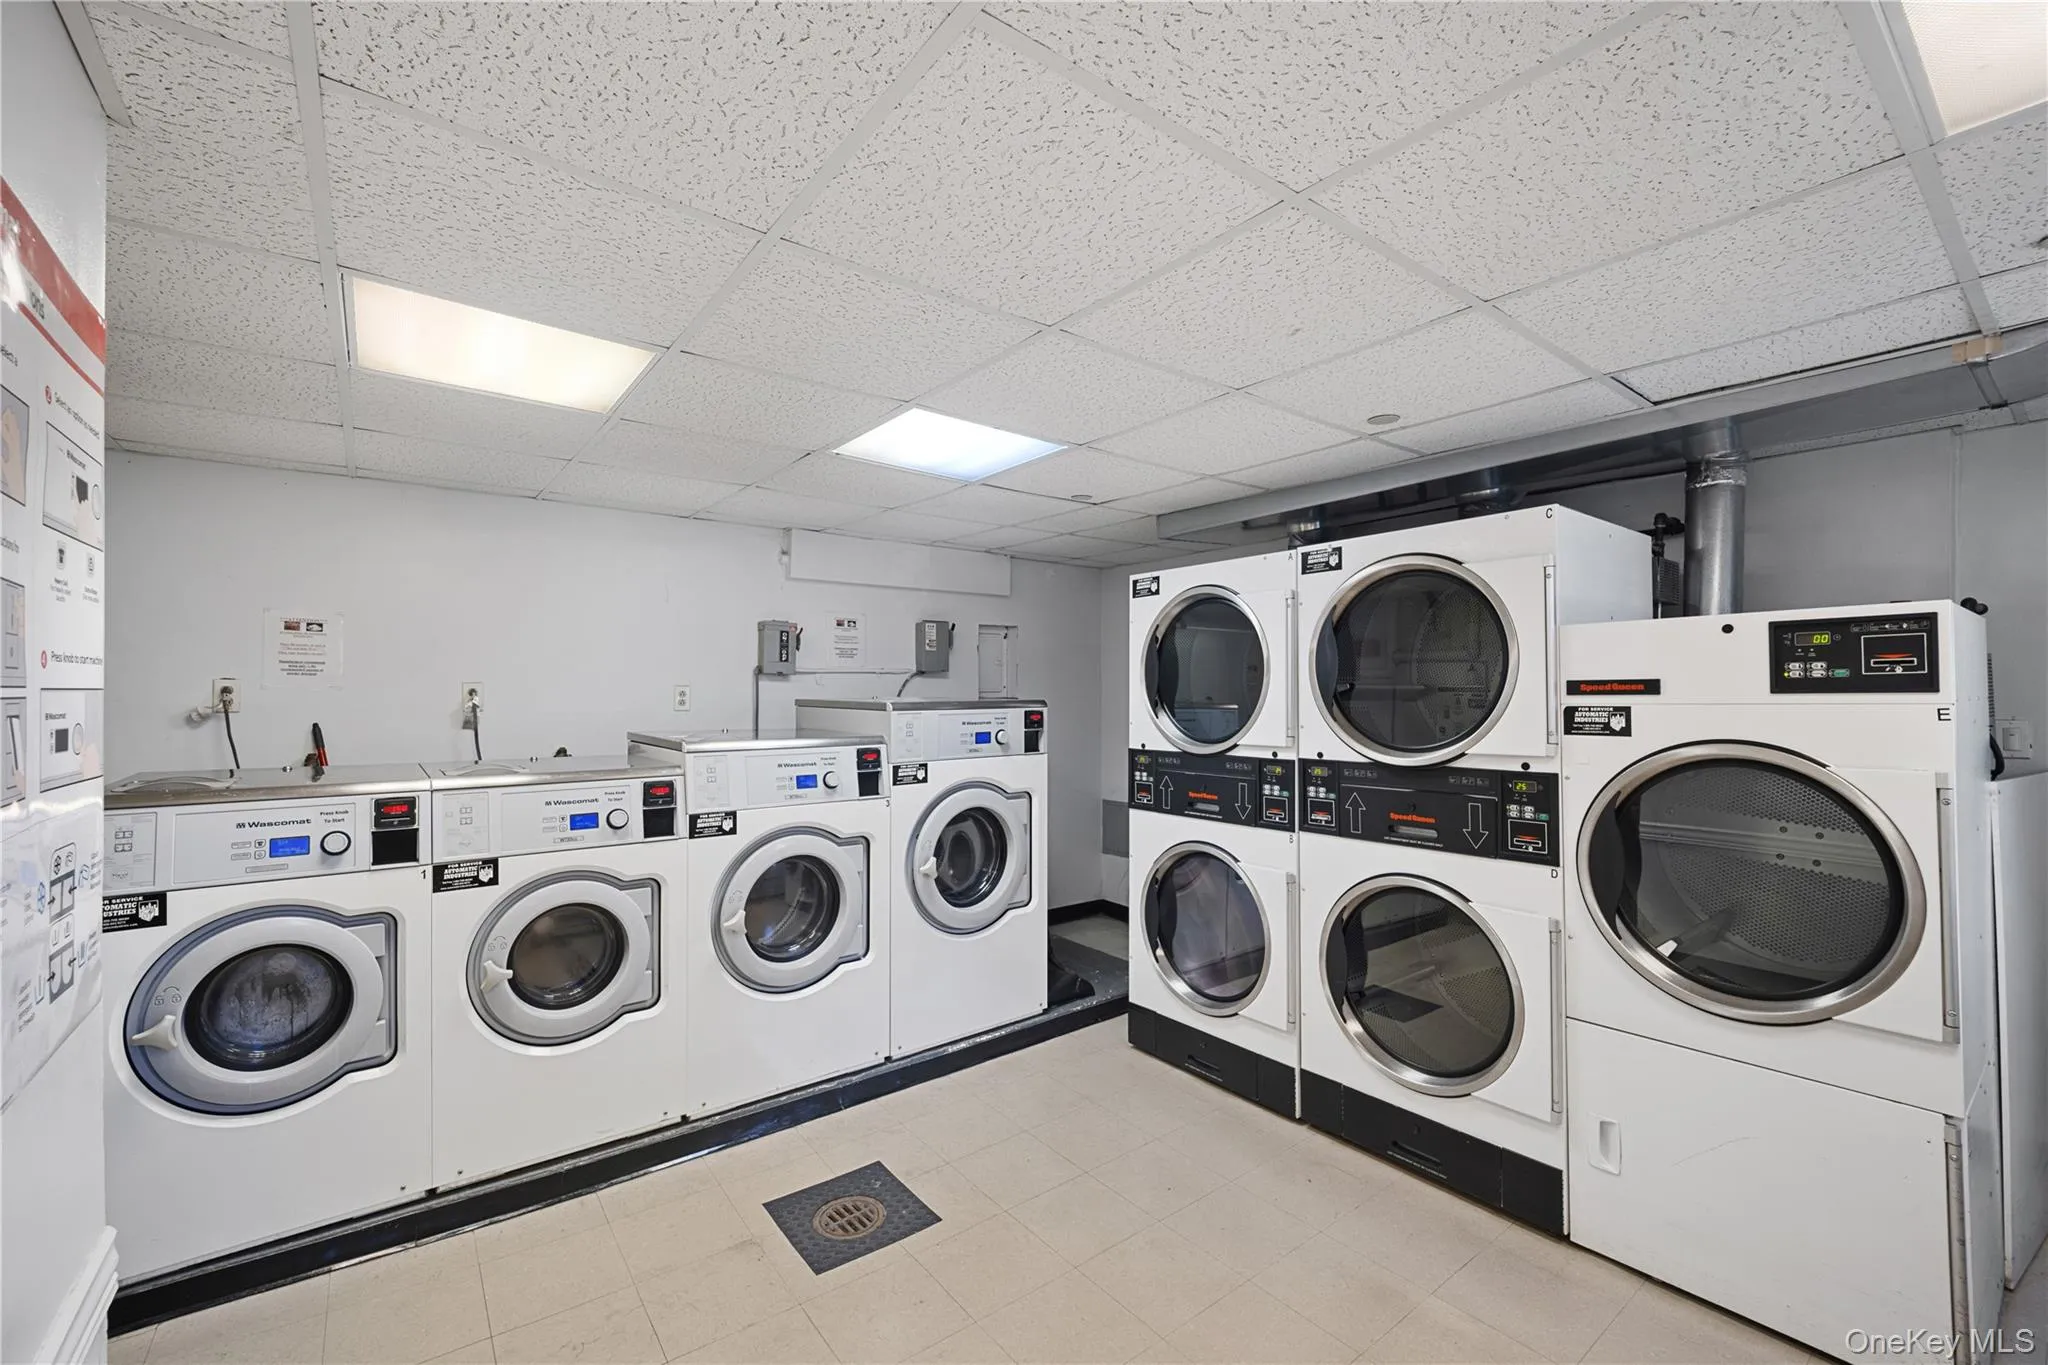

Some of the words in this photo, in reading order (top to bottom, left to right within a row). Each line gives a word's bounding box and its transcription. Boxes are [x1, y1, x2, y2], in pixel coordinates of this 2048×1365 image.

[1546, 508, 1552, 518] C
[1288, 552, 1294, 560] A
[1813, 634, 1829, 644] 00
[1580, 683, 1612, 692] Speed
[1612, 683, 1645, 691] Queen
[1937, 708, 1952, 721] E
[1516, 782, 1527, 790] 25
[553, 797, 599, 806] Wascomat
[1390, 812, 1412, 821] Speed
[1412, 814, 1436, 823] Queen
[248, 818, 312, 829] Wascomat
[421, 869, 426, 879] 1
[1551, 868, 1558, 879] D
[111, 896, 144, 904] SERVICE
[103, 908, 137, 917] USTRIES
